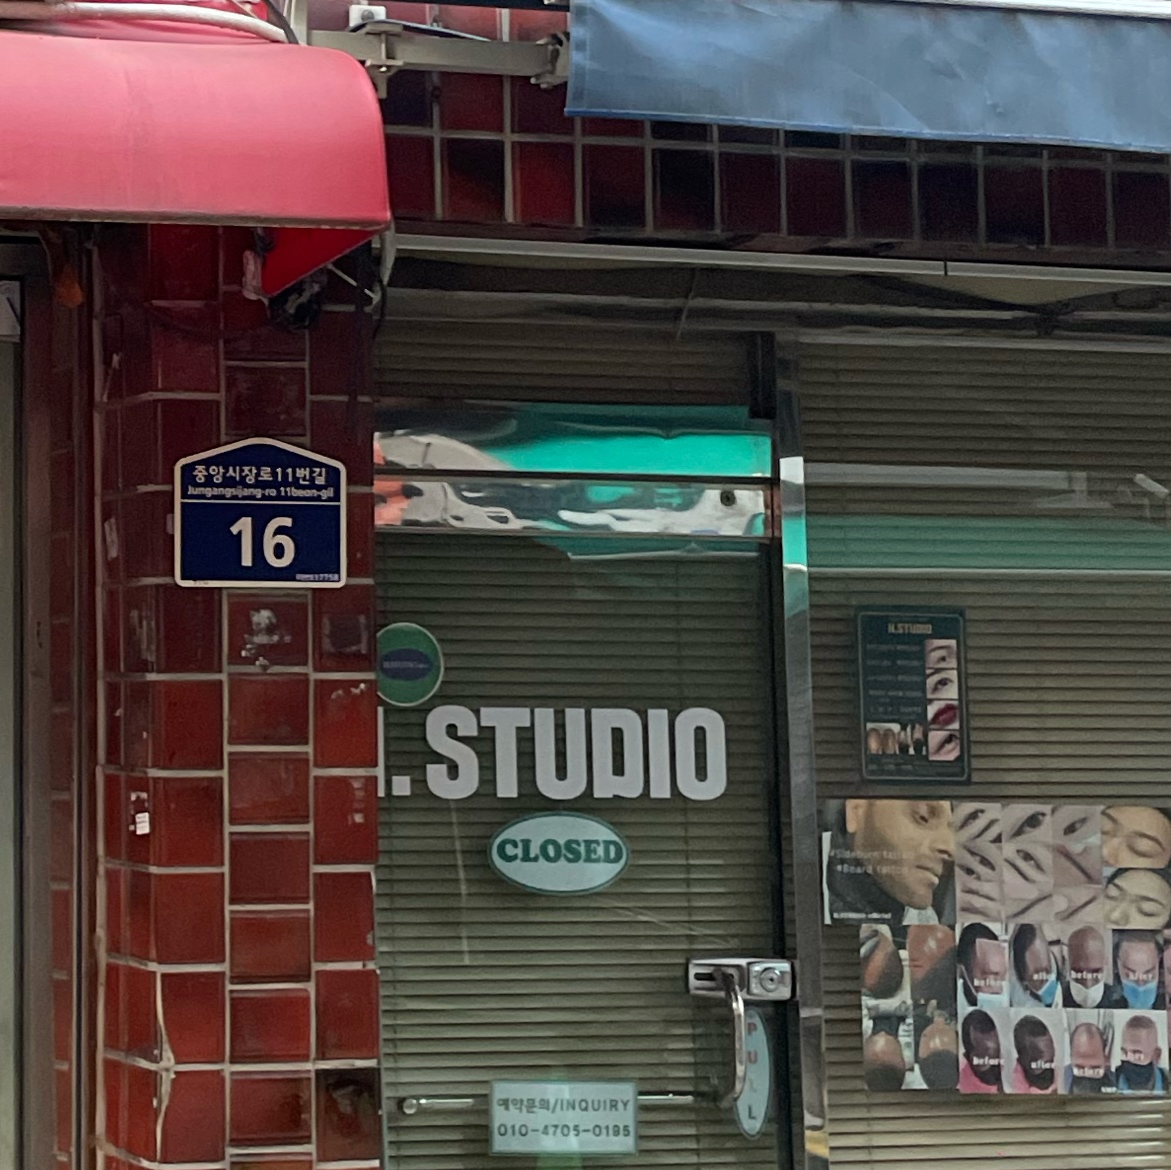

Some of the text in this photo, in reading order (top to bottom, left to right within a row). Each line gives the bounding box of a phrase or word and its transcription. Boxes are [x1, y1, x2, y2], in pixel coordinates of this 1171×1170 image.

[192, 465, 327, 485] 중앙시장로11번길
[187, 485, 276, 498] Jungangsijang-ro
[229, 516, 296, 568] 16
[495, 838, 624, 864] CLOSED
